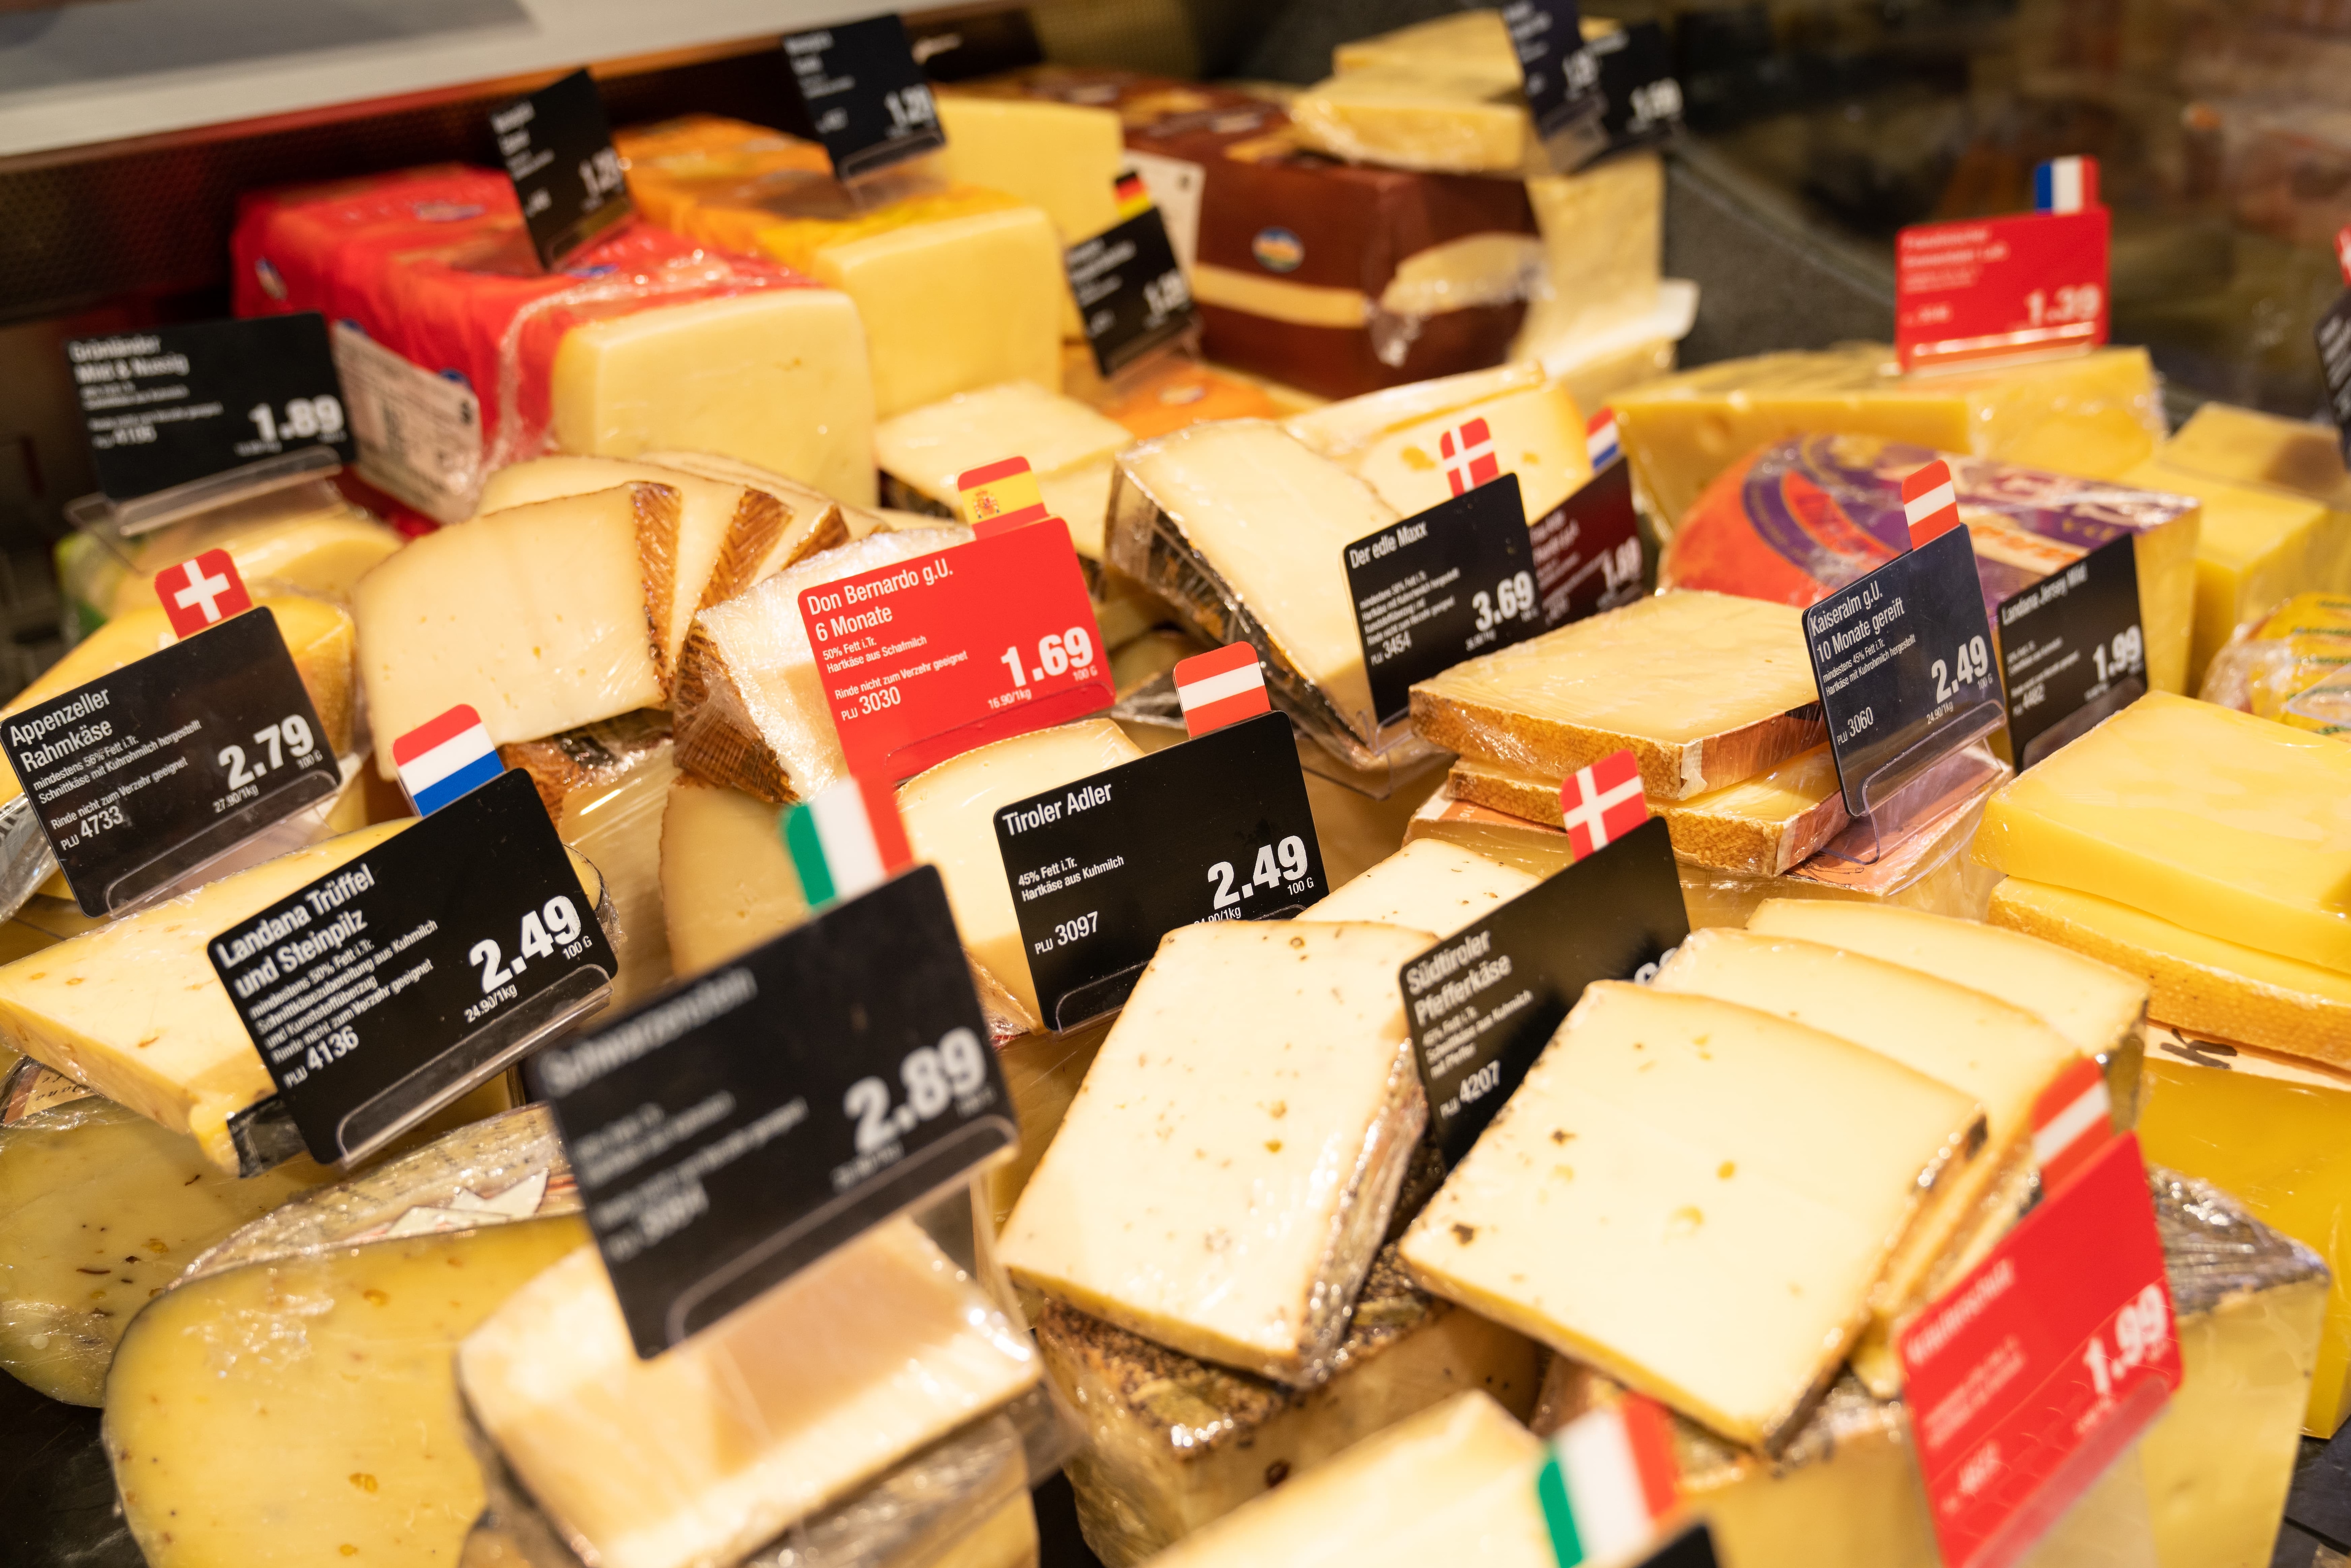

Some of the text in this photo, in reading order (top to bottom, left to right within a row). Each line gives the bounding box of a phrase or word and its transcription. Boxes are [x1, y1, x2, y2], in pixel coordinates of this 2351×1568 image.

[250, 395, 343, 445] 1.89
[1349, 522, 1427, 568] Der edle Maxx
[807, 558, 953, 615] Don Bernardo g.U.
[1472, 571, 1533, 631] 3.69
[1808, 580, 1882, 636] Kaiseralm g.U.
[2002, 593, 2040, 625] Landana
[2039, 577, 2067, 604] Jersey
[815, 606, 892, 641] 6 Monate
[822, 637, 876, 660] 50% Fett i.Tr.
[1382, 630, 1411, 658] 3454
[1817, 597, 1904, 662] 10 Monate gereift
[827, 635, 927, 673] Hartkäse aus Schafmilch
[835, 650, 967, 699] Rinde nicht zum Verzehr geeignet
[1001, 627, 1093, 687] 1.69
[1822, 638, 1885, 683] mindestens 45% Fett i.Tr.
[1825, 634, 1915, 696] Hartkäse mit Kuhrohmilch hergestellt
[1931, 635, 1990, 704] 2.49
[2093, 626, 2141, 681] 1.99
[841, 686, 900, 720] PLU 3030
[988, 689, 1031, 708] 16.90/1kg
[1073, 668, 1089, 680] 100
[1926, 701, 1953, 725] 24.90/1kg
[1977, 677, 1988, 690] 100
[10, 689, 110, 747] Appenzeller
[1837, 706, 1873, 745] PLU 3060
[20, 721, 112, 772] Rahmkäse
[33, 735, 139, 790] mindestens 56% Fett i.Tr.
[39, 720, 201, 804] Schnittkäse mit Kuhrohmilch hergestellt
[218, 714, 314, 790] 2.79
[50, 756, 188, 829] Rinde nicht zum Verzehr geeignet
[213, 785, 259, 812] 27.90/1kg
[297, 754, 314, 768] 100
[1002, 784, 1111, 835] Tiroler Adler
[60, 805, 123, 850] PLU 4733
[1018, 857, 1077, 886] 45% Fett i.Tr.
[1021, 855, 1124, 901] Hartkäse aus Kuhmilch
[1207, 835, 1307, 910] 2.49
[217, 863, 374, 968] Landana Trüffel
[1194, 877, 1314, 924] 90/1kg 100 G
[235, 910, 367, 997] und Steinpilz
[374, 947, 393, 965] aus
[391, 920, 437, 952] Kuhmilch
[469, 896, 581, 993] 2.49
[1034, 911, 1097, 954] PLU 3097
[250, 977, 310, 1018] mindestens
[308, 962, 335, 983] 50%
[332, 949, 356, 968] Fett
[465, 936, 592, 1022] 24.90/1kg 100 G
[1406, 931, 1489, 994] Südtiroler
[1414, 955, 1511, 1025] Pfefferkäse
[266, 976, 378, 1048] und Kunststoffüberzug
[272, 958, 433, 1062] Rinde nicht zum Verzehr geeignet
[1491, 991, 1531, 1022] Kuhmilch
[284, 1025, 358, 1086] PLU 4136
[1460, 1060, 1499, 1102] 4207
[845, 1028, 987, 1161] 2.89
